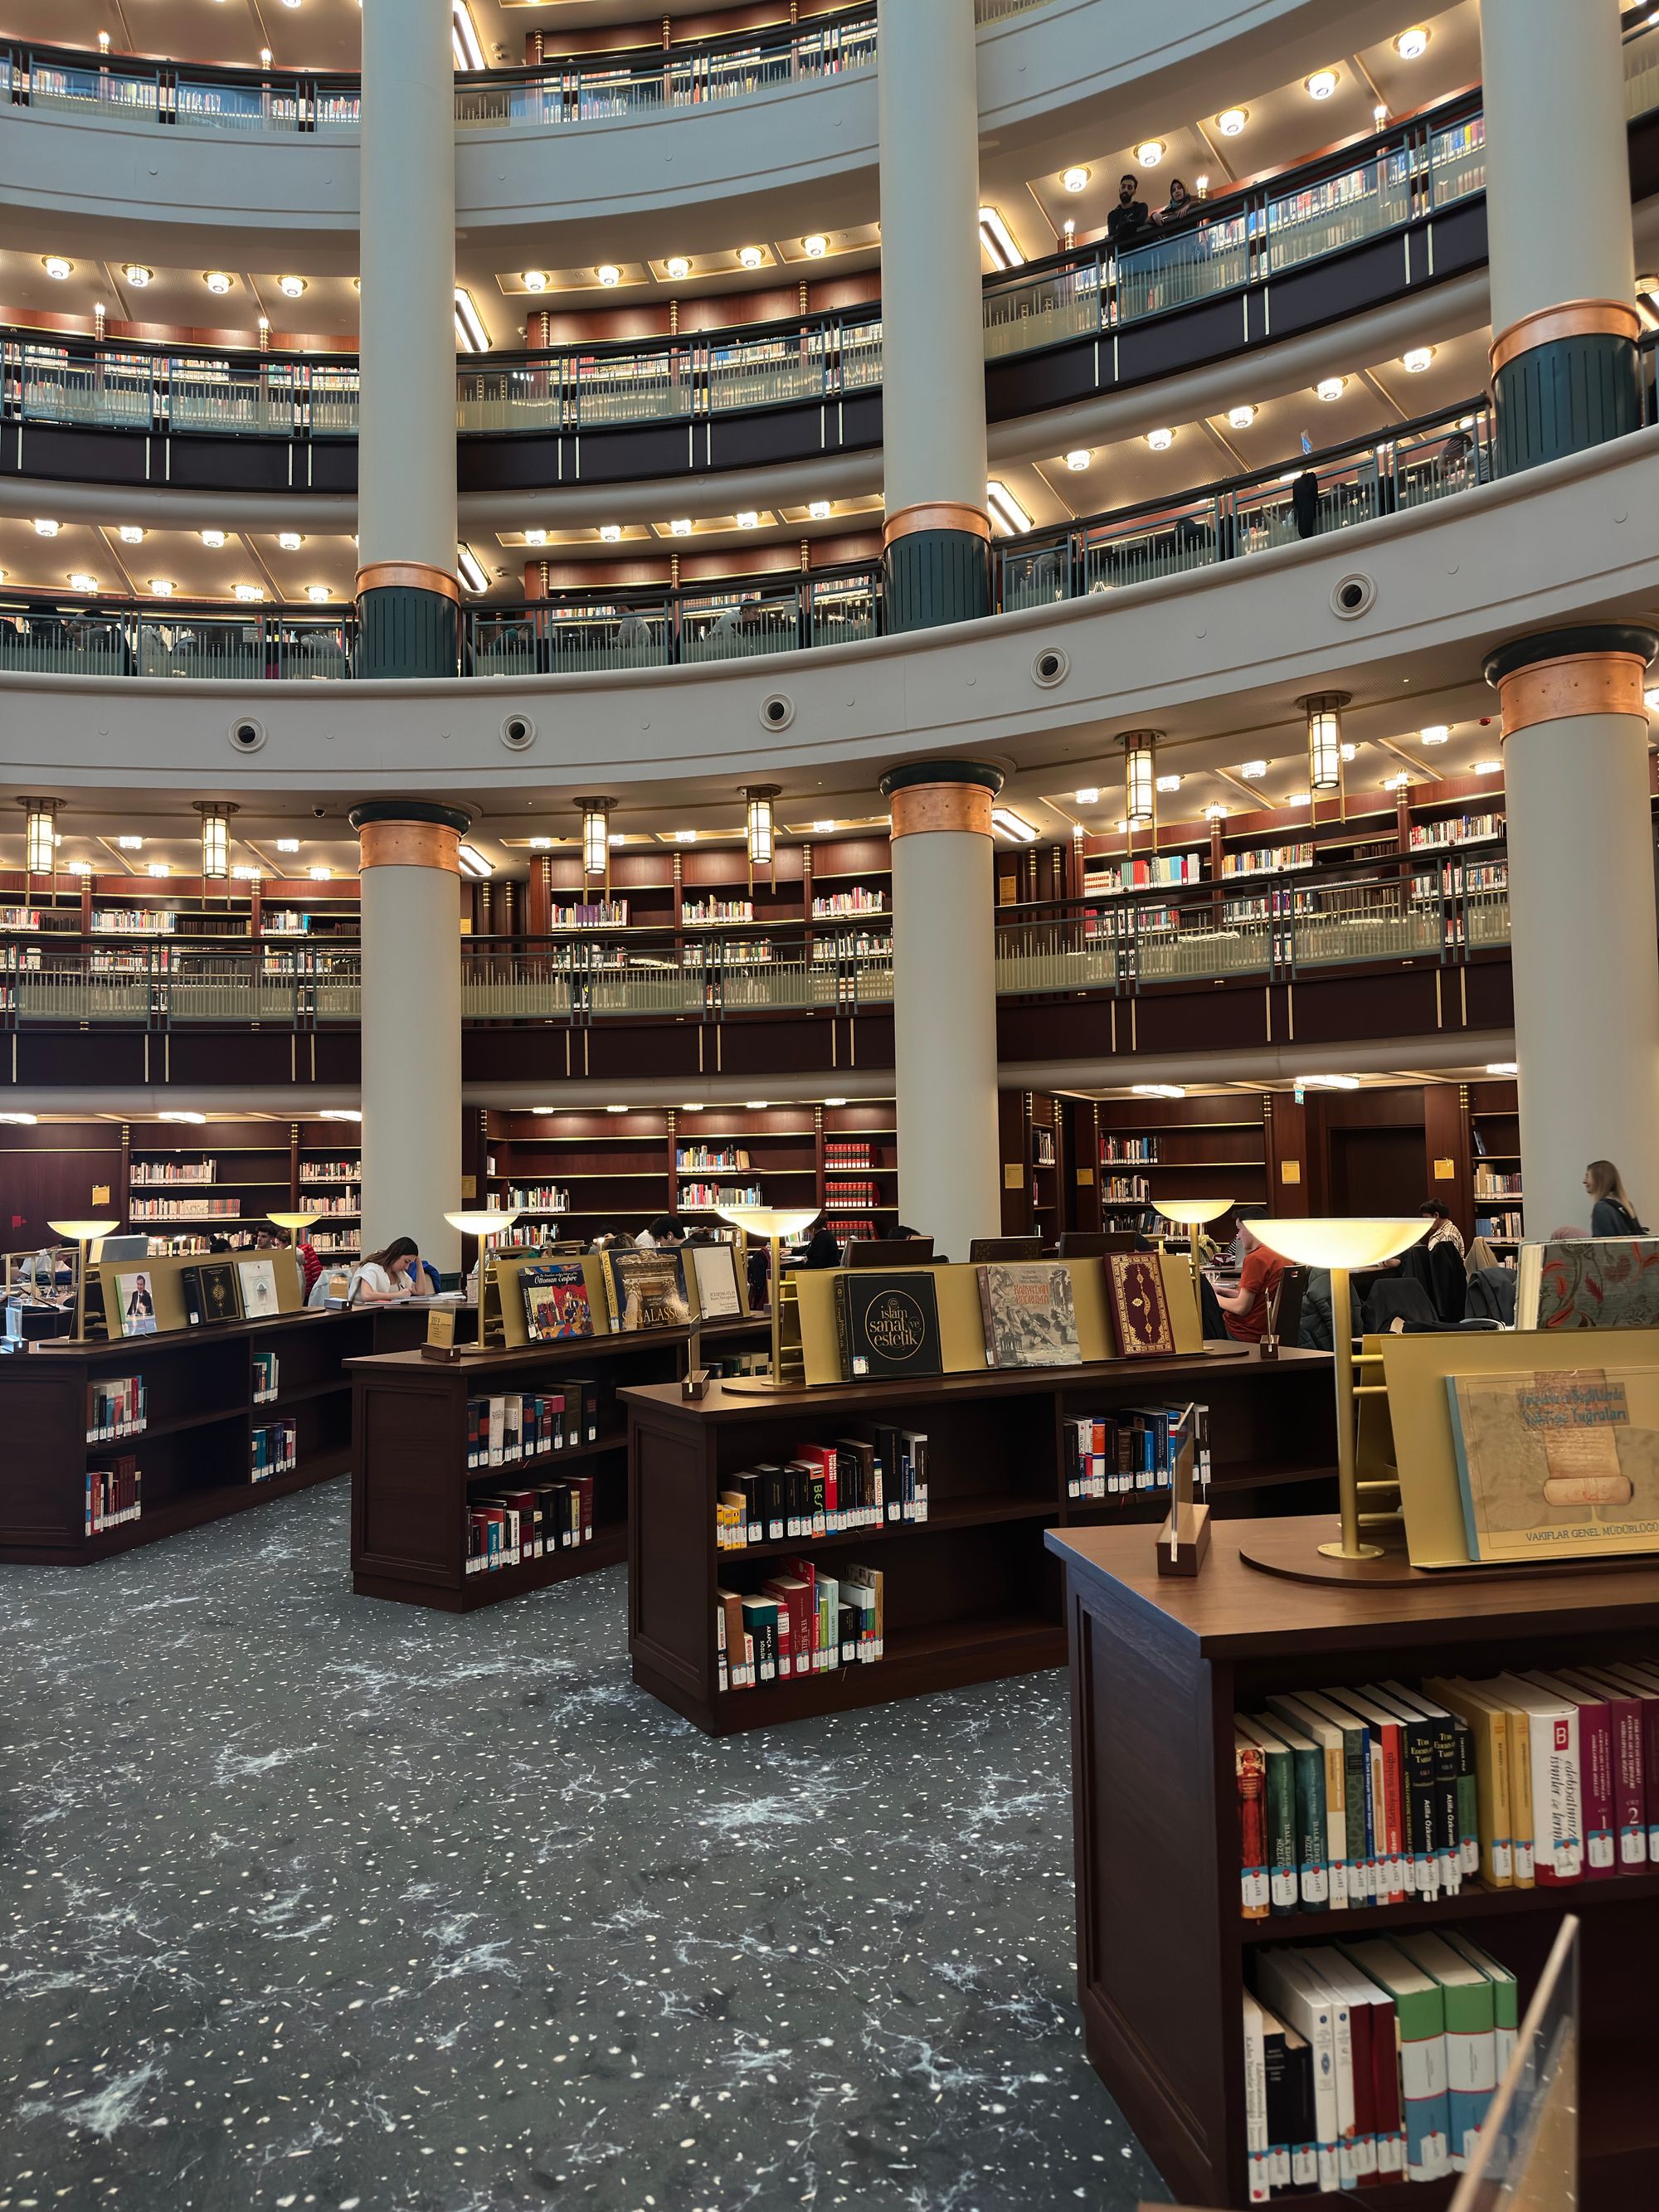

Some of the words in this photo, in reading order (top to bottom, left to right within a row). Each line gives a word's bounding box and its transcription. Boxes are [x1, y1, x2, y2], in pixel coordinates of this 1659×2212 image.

[534, 1275, 557, 1284] Ottoman
[869, 1317, 905, 1333] sanat
[873, 1330, 918, 1346] estetik
[1525, 1529, 1569, 1542] VAKIFLAR
[1571, 1528, 1600, 1539] GENEL
[1556, 1727, 1566, 1745] B
[1627, 1806, 1640, 1825] 2
